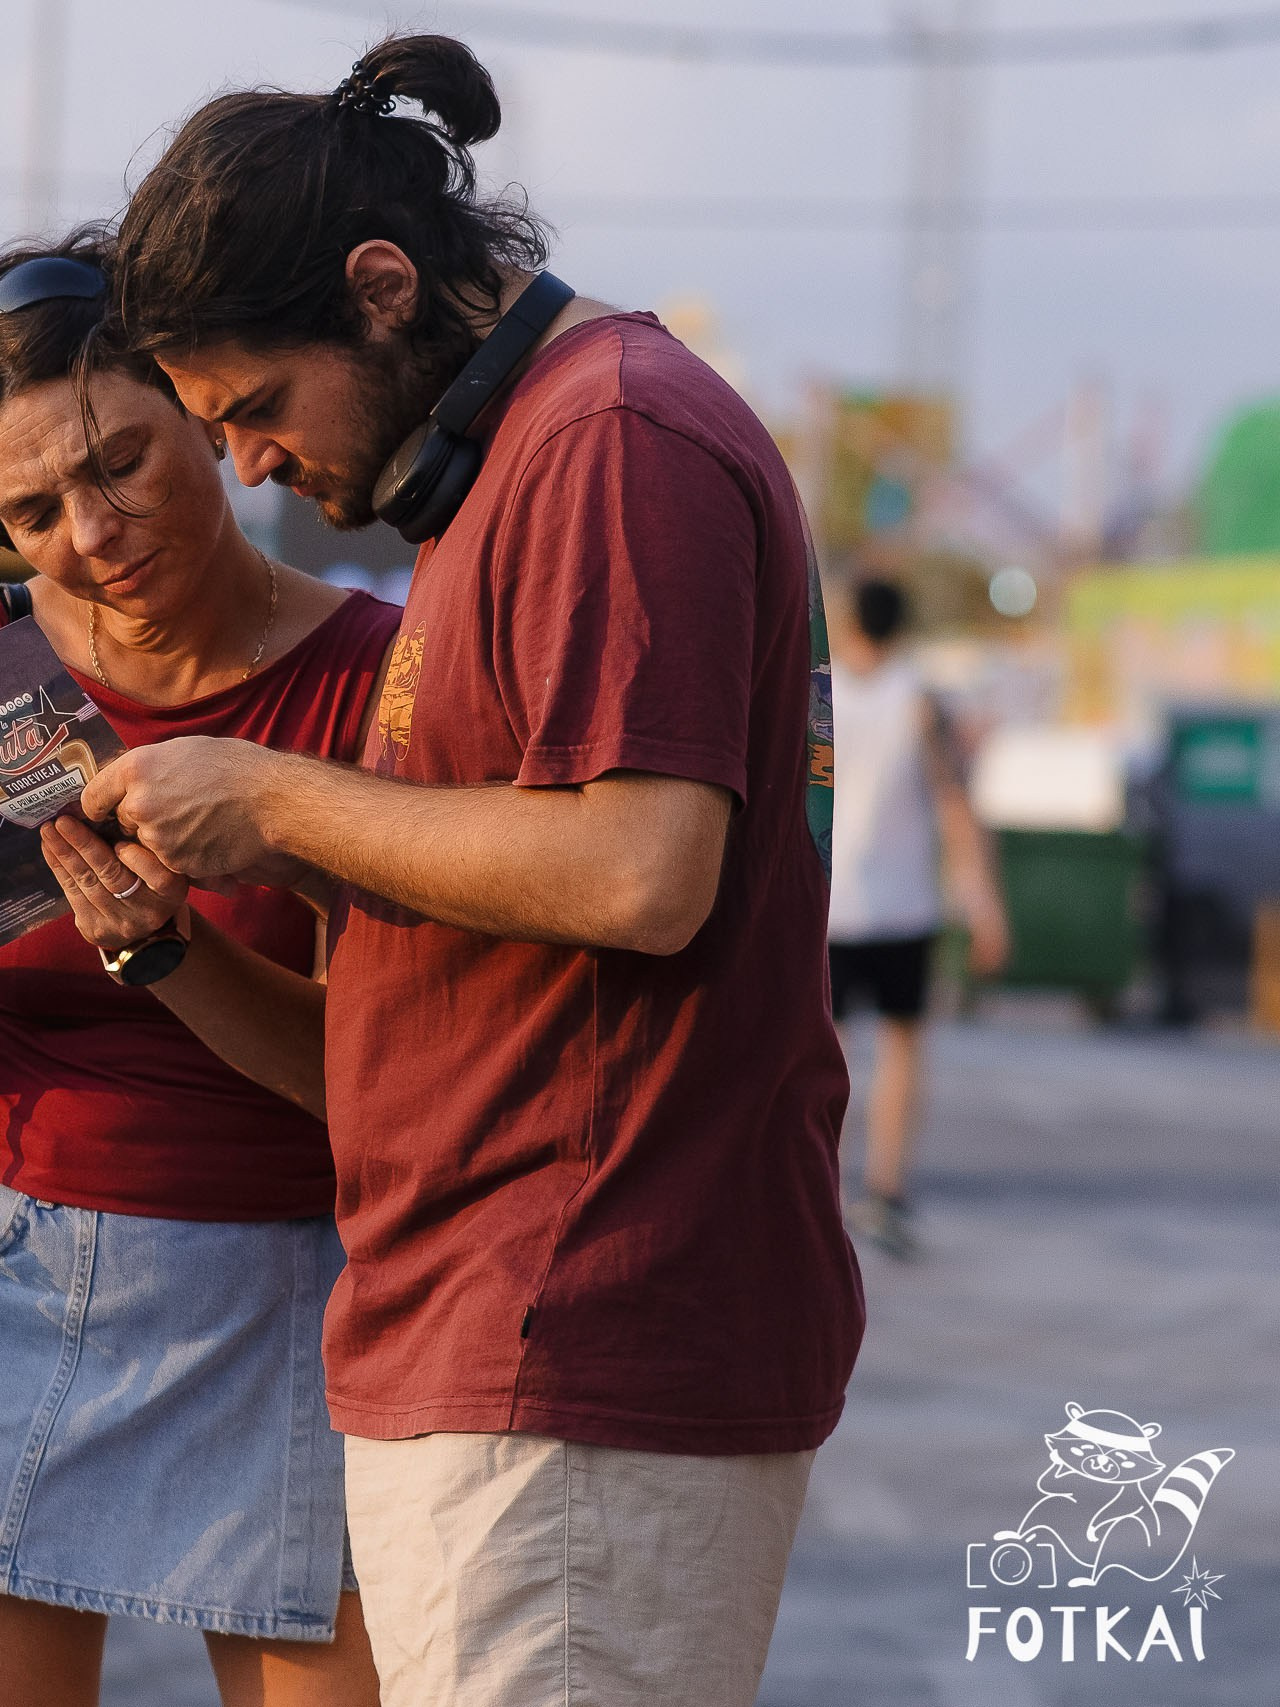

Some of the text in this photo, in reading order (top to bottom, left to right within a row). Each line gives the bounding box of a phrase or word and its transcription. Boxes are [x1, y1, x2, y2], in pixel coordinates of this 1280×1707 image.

[6, 763, 61, 793] TORREVIEJA
[8, 803, 20, 811] EL
[17, 793, 40, 807] PRIMER
[40, 776, 77, 798] CAMPEONATO
